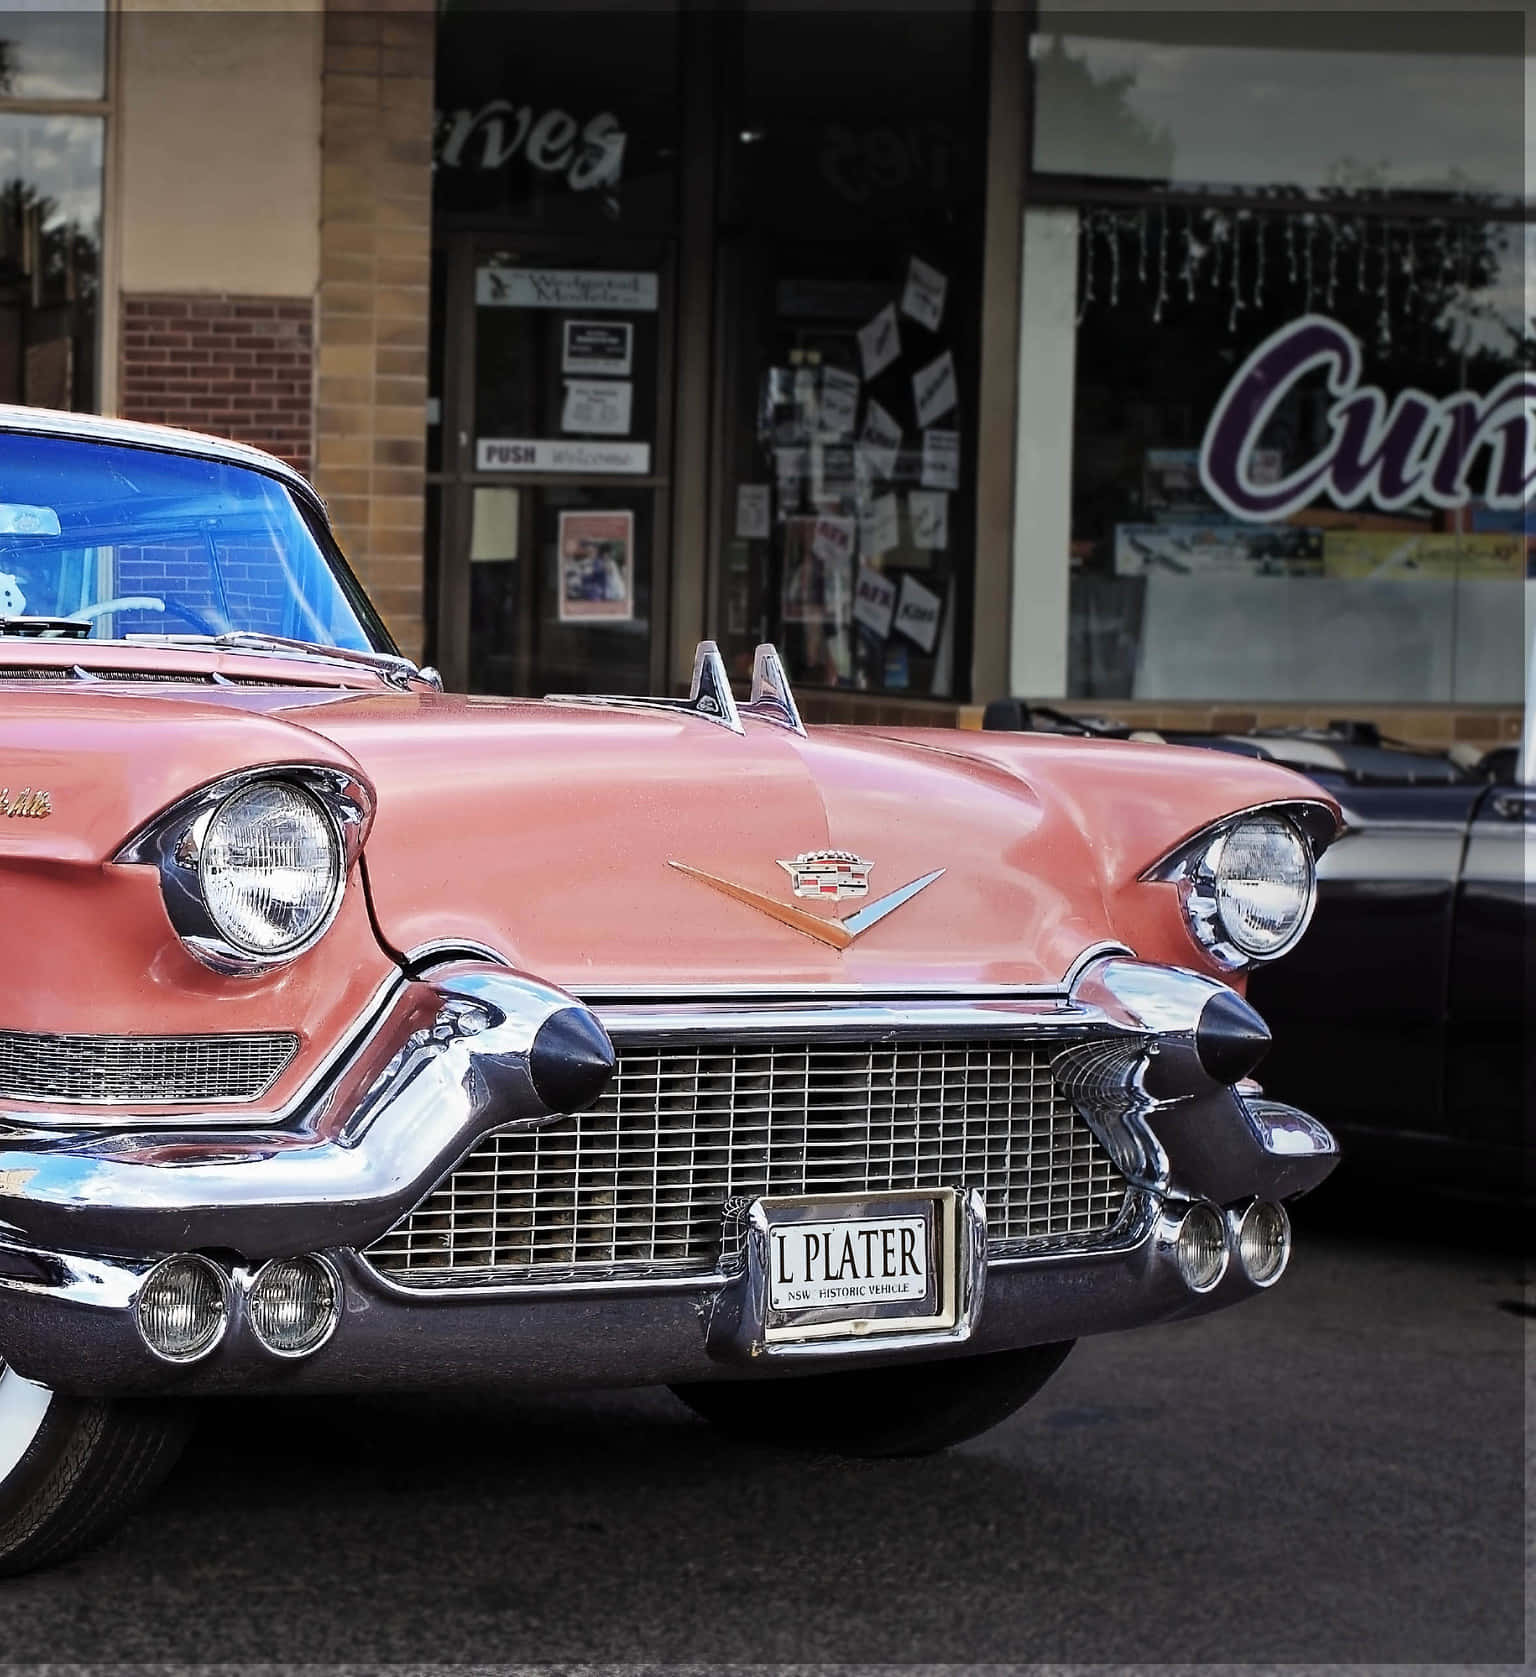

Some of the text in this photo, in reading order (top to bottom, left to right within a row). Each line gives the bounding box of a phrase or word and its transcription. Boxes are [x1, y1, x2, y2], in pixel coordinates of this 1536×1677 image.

[432, 99, 622, 190] rves
[485, 446, 537, 464] PUSH
[777, 1227, 923, 1284] L PLATER
[788, 1283, 910, 1301] NSW HISTORIC VEHICLE
